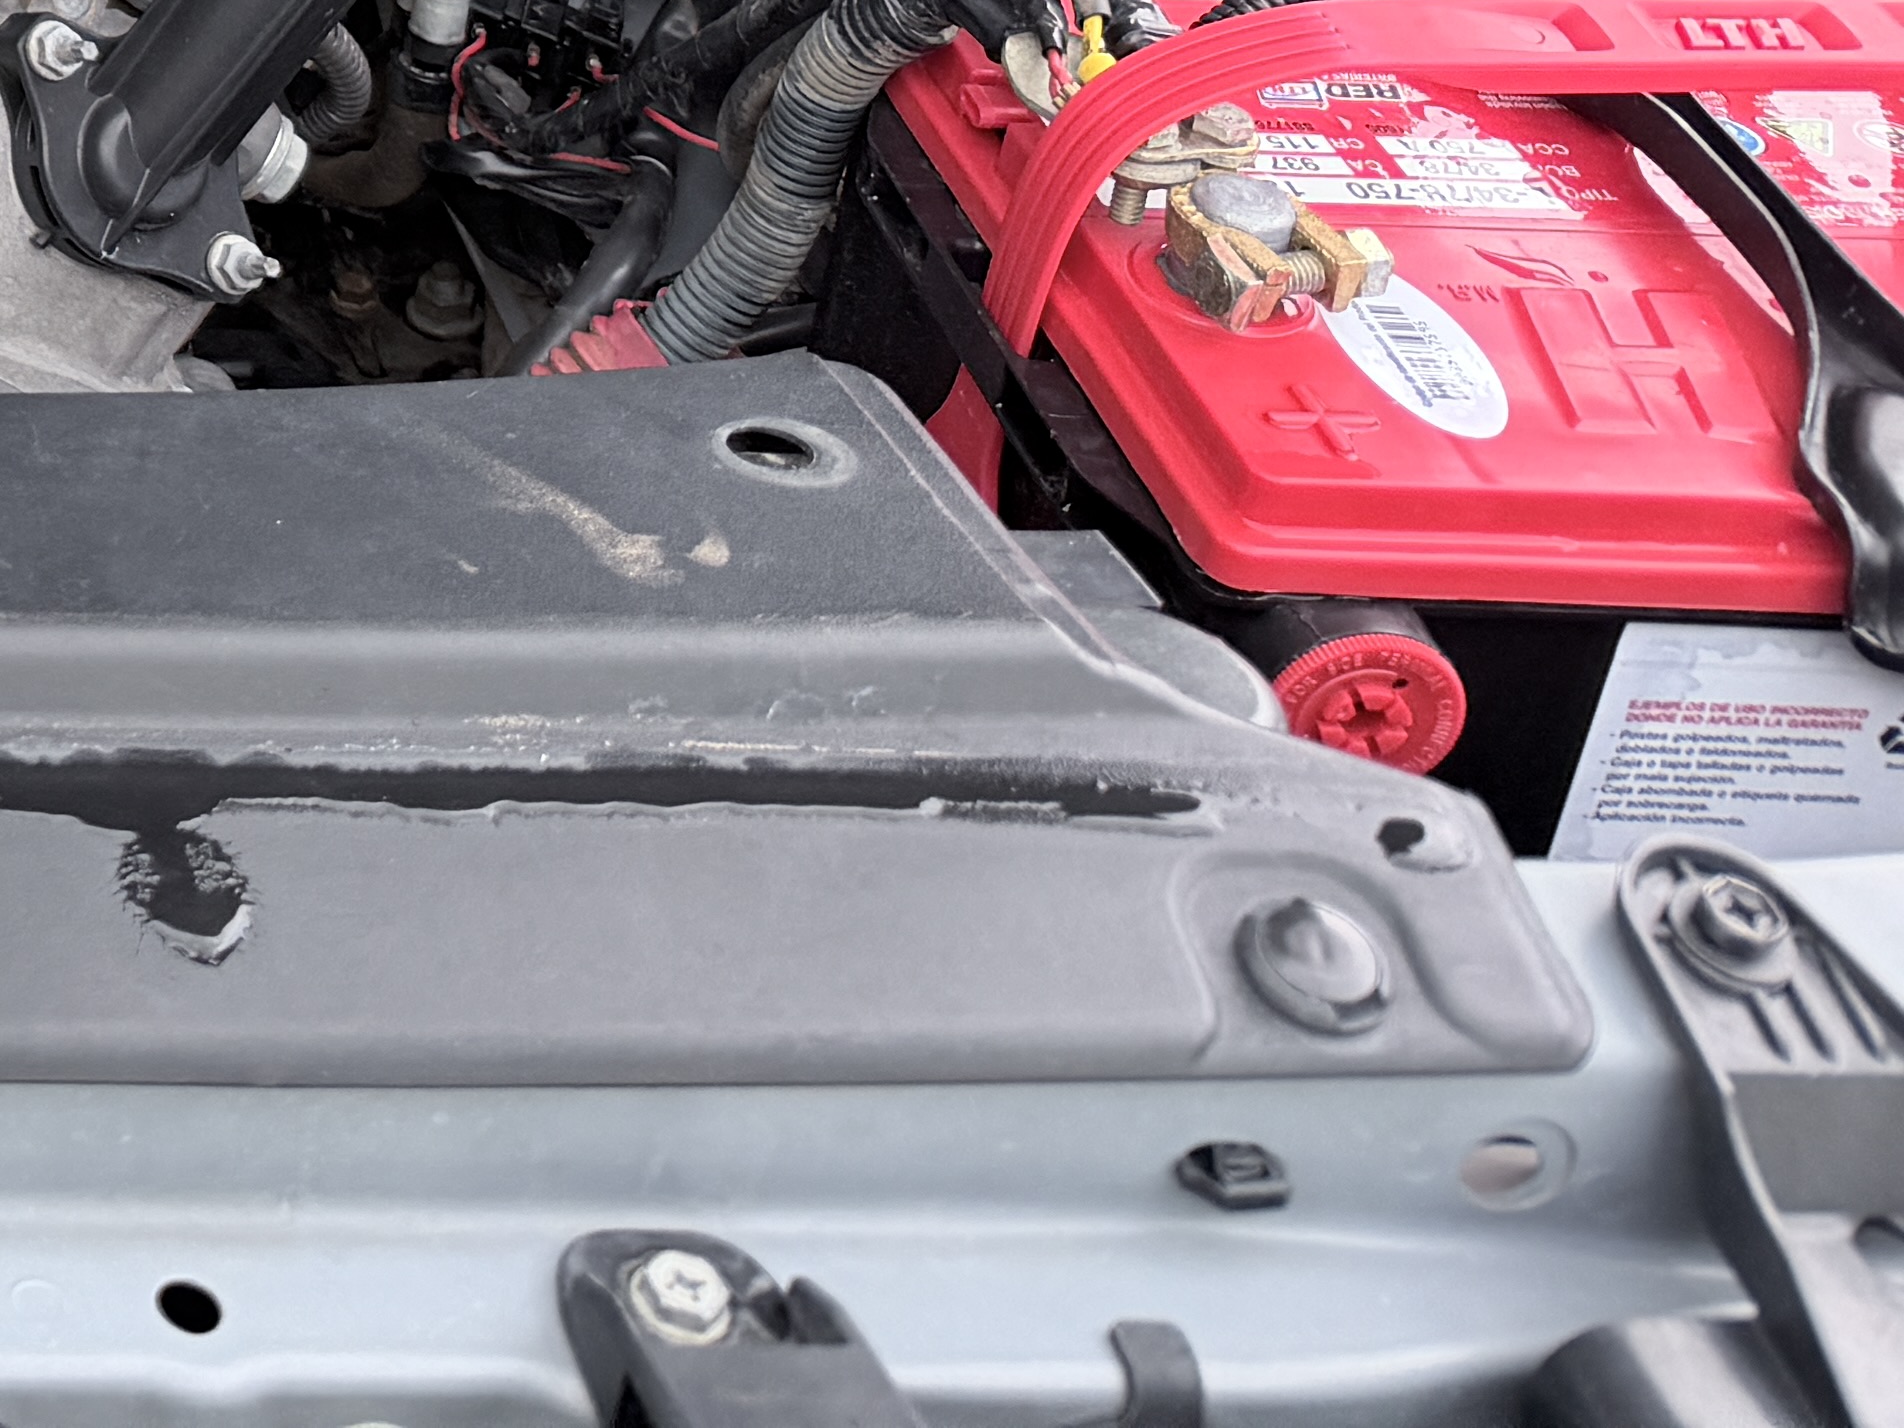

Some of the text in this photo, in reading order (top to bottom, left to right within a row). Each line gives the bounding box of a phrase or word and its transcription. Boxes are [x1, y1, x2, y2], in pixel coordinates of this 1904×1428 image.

[1675, 16, 1805, 51] LTH
[1324, 82, 1398, 100] RED
[1265, 135, 1320, 150] 115
[1517, 143, 1570, 157] CCA
[1270, 156, 1320, 172] 937
